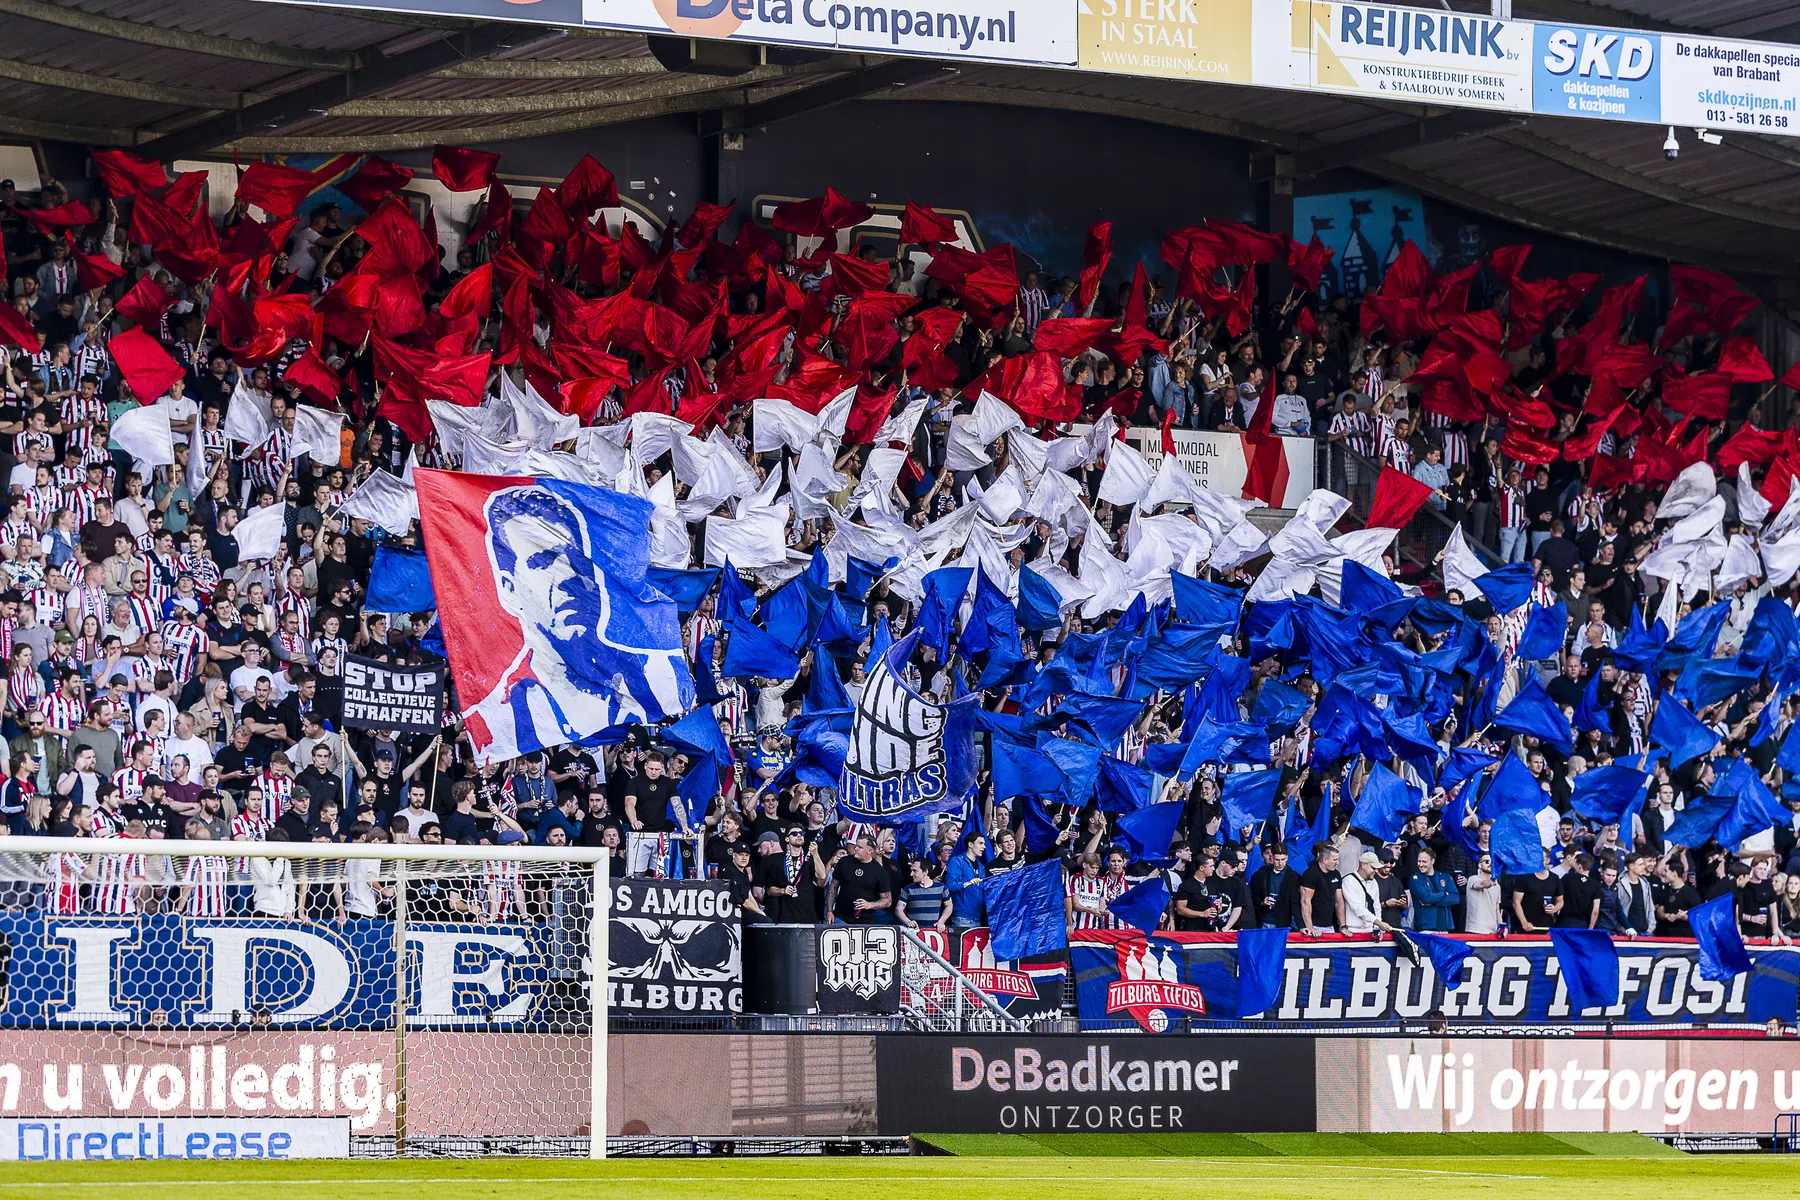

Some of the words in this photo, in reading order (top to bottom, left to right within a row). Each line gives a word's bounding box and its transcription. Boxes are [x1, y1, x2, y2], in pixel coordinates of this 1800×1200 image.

[803, 0, 1016, 51] Company.nl
[1101, 20, 1125, 43] IN
[1133, 24, 1198, 49] STAAL
[1341, 6, 1505, 60] REIJRINK
[1506, 49, 1520, 61] bv
[1101, 51, 1229, 74] WWW.REIJRINK.COM
[1544, 29, 1654, 82] SKD
[1676, 42, 1691, 57] De
[1694, 45, 1761, 63] dakkapellen
[1363, 64, 1469, 84] KONSTRUKTIEBEDRIJF
[1472, 75, 1505, 88] ESBEEK
[1713, 66, 1733, 77] van
[1736, 66, 1781, 82] Brabant
[1379, 82, 1387, 90] &
[1392, 82, 1455, 97] STAALBOUW
[1458, 90, 1505, 101] SOMEREN
[1563, 80, 1630, 99] dakkapellen
[1698, 89, 1796, 112] skdkozijnen.nl
[1568, 96, 1577, 110] &
[1579, 97, 1626, 115] kozijnen
[1706, 109, 1726, 122] 013
[1736, 112, 1755, 125] 581
[1759, 114, 1772, 126] 26
[1775, 116, 1788, 128] 58
[1148, 439, 1219, 457] MUIMODAL
[344, 661, 437, 693] STOP
[344, 687, 436, 709] COLLECTIEVE
[344, 702, 435, 725] STRAFFEN
[641, 888, 741, 919] AMIGO
[820, 926, 898, 968] 013
[824, 954, 894, 1001] boys
[996, 974, 1031, 993] TIFOSI
[1241, 956, 1531, 1019] ILBURG
[1545, 956, 1756, 1017] TFOSI
[1110, 984, 1161, 1007] TILBURG
[1162, 985, 1204, 1009] TIFOSI
[951, 1046, 1239, 1092] DeBadkamer
[43, 1063, 83, 1111] u
[1387, 1053, 1475, 1126] Wij
[1491, 1059, 1759, 1125] ontzorgen
[1000, 1105, 1184, 1129] ONTZORGER
[18, 1122, 292, 1161] DirectLease
